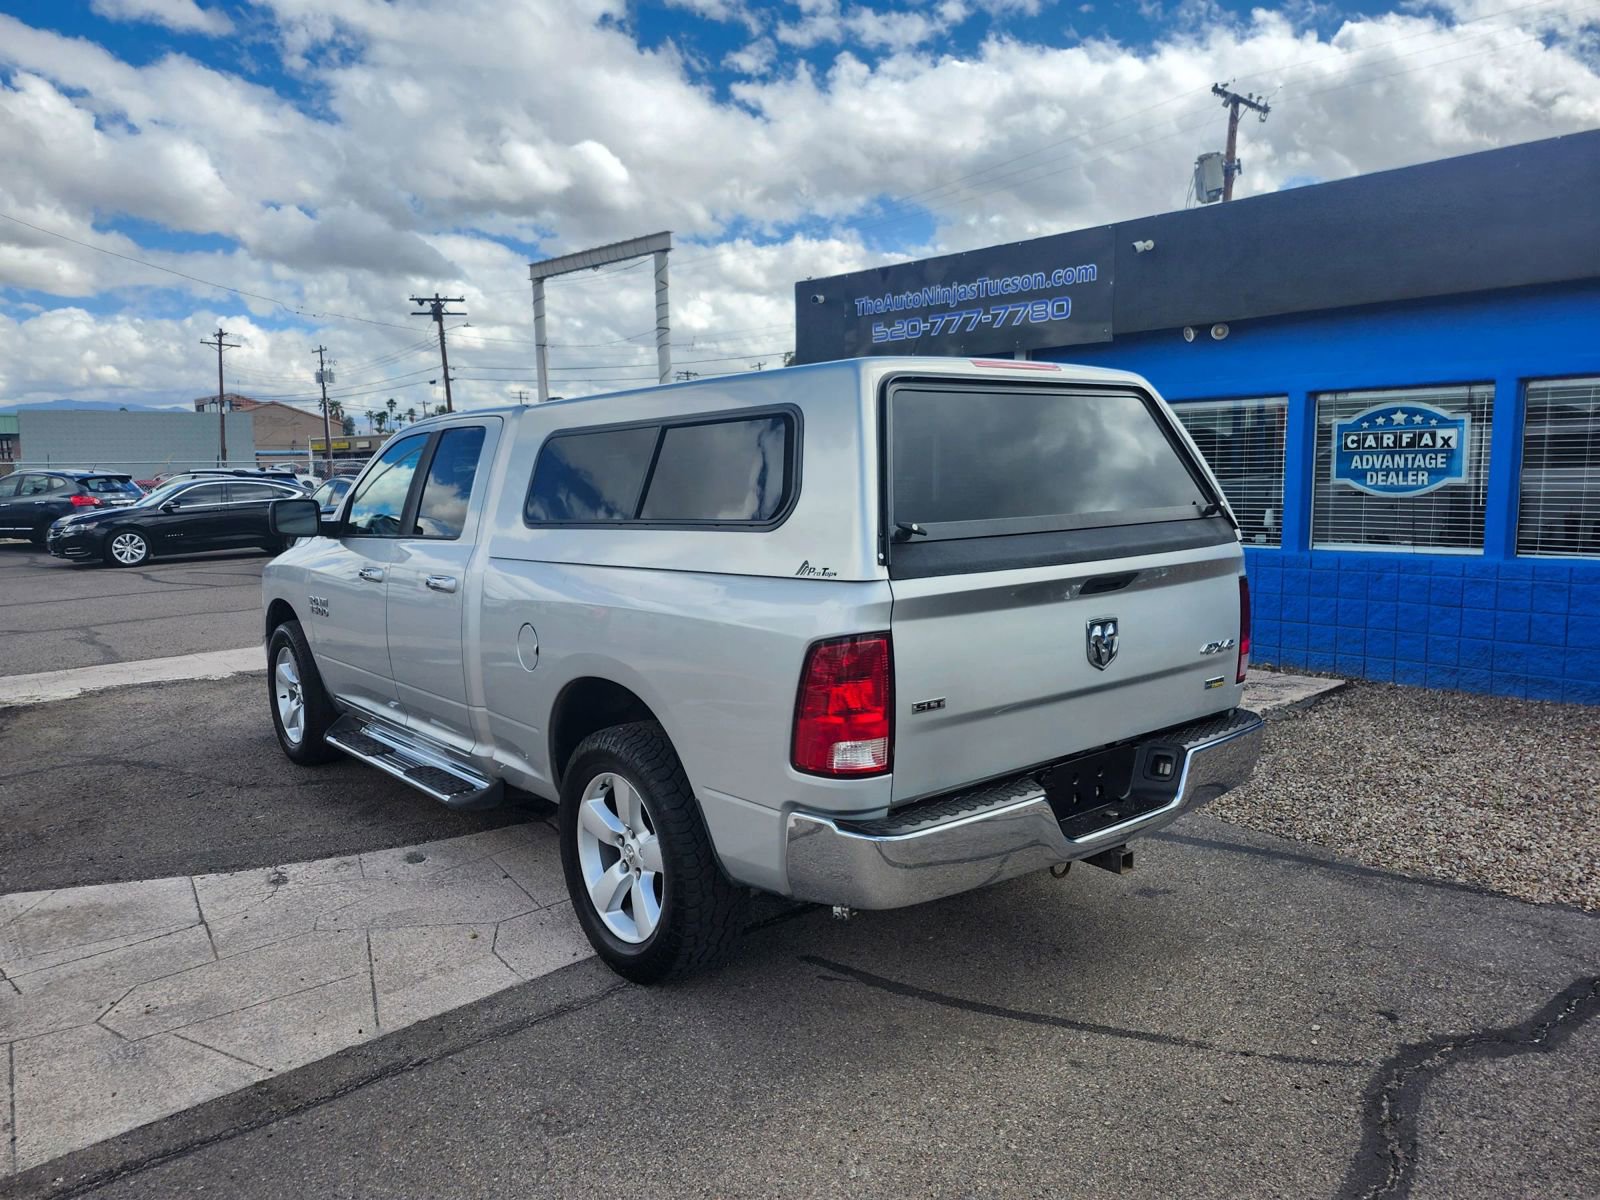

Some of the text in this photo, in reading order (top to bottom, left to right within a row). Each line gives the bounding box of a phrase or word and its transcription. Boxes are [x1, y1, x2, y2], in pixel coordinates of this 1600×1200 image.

[855, 263, 1097, 316] TheAutoNinjasTucson.com
[872, 296, 1071, 343] 520-777-7780
[1346, 433, 1453, 449] CARFAX
[1351, 453, 1446, 469] ADVANTAGE
[1366, 470, 1429, 486] DEALER
[914, 698, 945, 712] SLT
